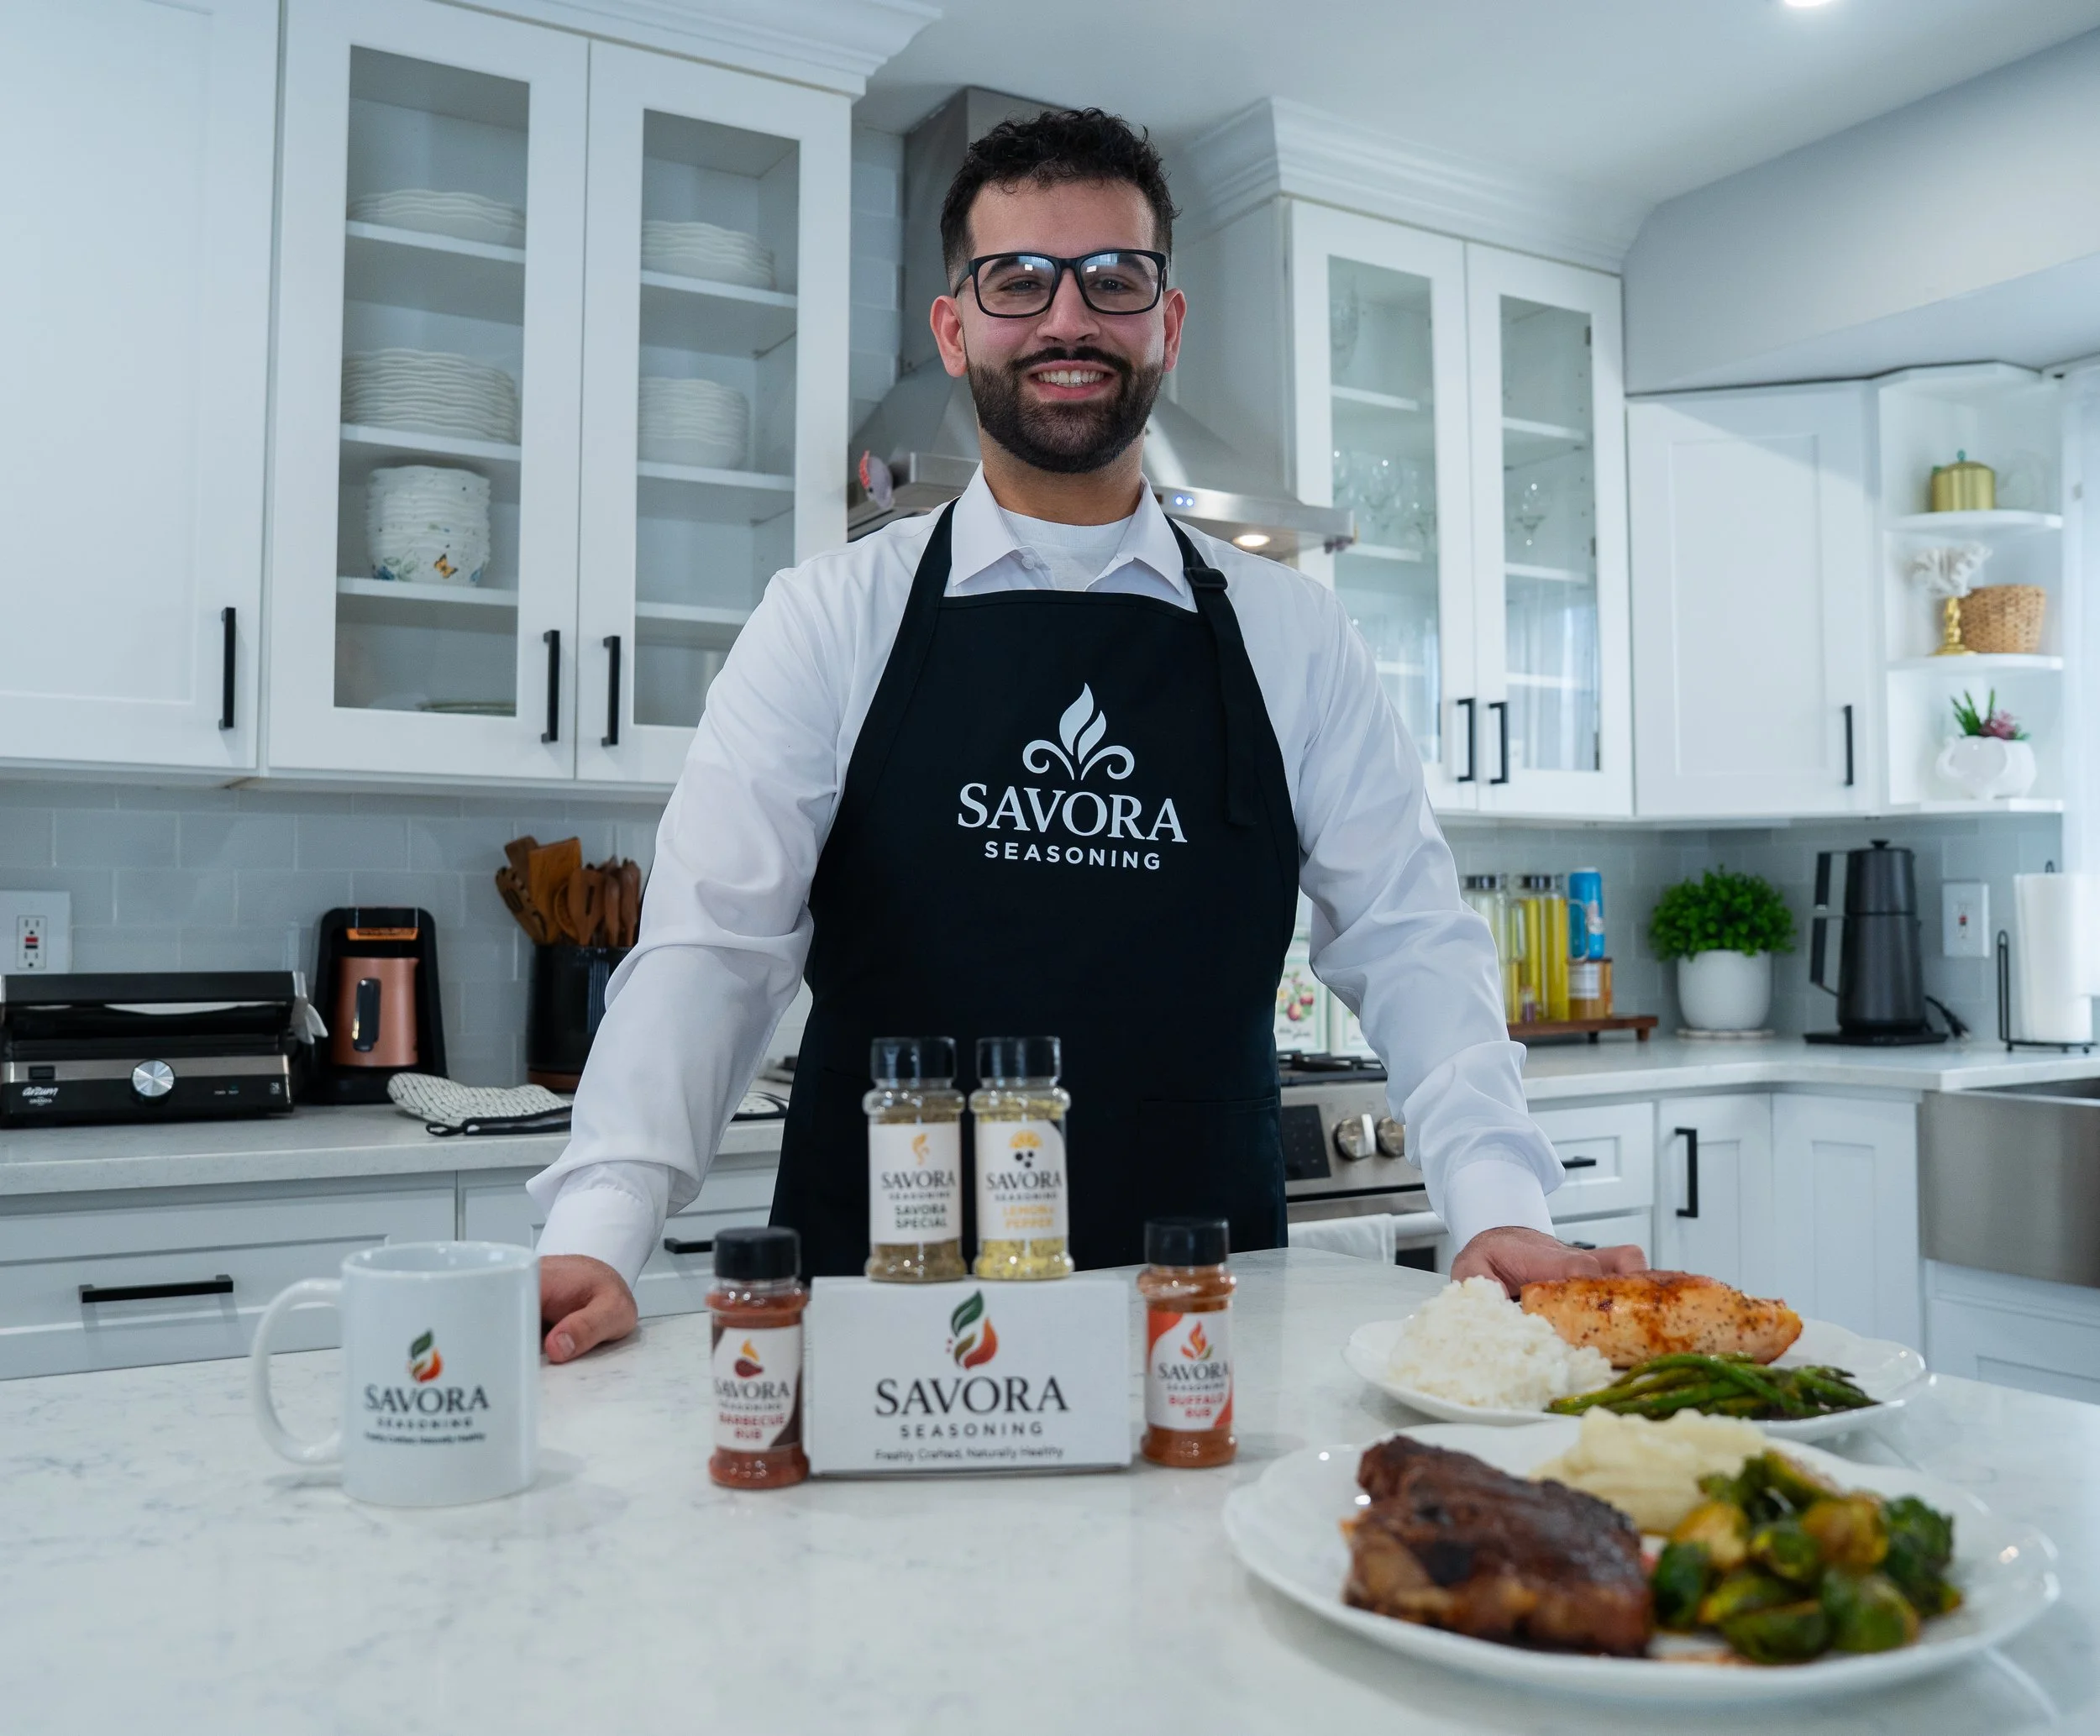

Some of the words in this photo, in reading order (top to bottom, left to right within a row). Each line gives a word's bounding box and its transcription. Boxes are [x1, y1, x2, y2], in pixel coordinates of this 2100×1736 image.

[958, 783, 1188, 843] SAVORA
[984, 841, 1160, 870] SEASONING
[881, 1170, 956, 1189] SAVORA
[986, 1170, 1063, 1190] SAVORA
[889, 1191, 950, 1199] SEASONING
[995, 1193, 1057, 1201] SEASONING
[895, 1204, 947, 1215] SAVORA
[895, 1217, 948, 1230] SPECIAL
[1158, 1361, 1229, 1380] SAVORA
[713, 1377, 790, 1398] SAVORA
[874, 1375, 1069, 1417] SAVORA
[364, 1384, 490, 1414] SAVORA
[1168, 1392, 1224, 1405] BUFFALO
[377, 1416, 473, 1429] SEASONING
[719, 1412, 785, 1426] BARBECUE
[1185, 1408, 1210, 1419] RUB
[734, 1428, 762, 1440] RUB
[900, 1421, 1043, 1440] SEASONING
[875, 1449, 914, 1462] Freshly
[968, 1445, 1016, 1460] Naturally
[1020, 1443, 1064, 1458] Healthy
